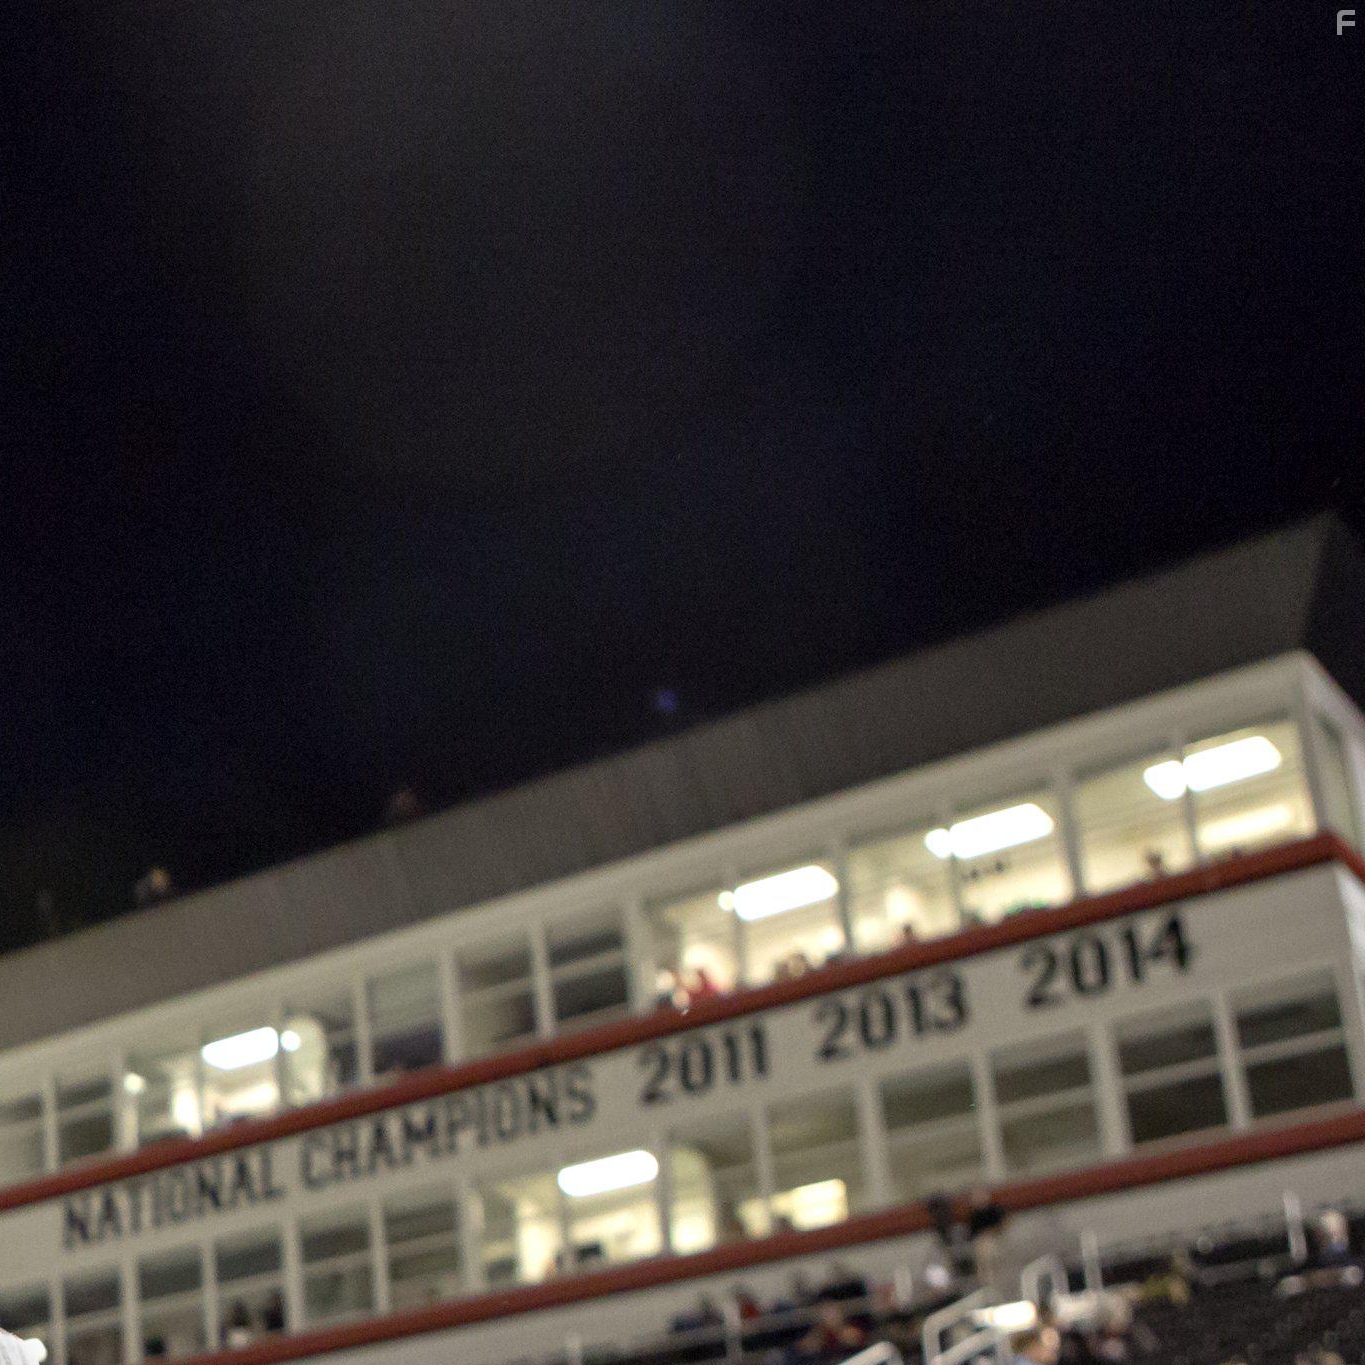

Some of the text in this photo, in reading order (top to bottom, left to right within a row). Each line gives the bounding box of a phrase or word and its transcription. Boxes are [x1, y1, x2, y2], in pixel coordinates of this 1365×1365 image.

[64, 912, 1193, 1249] NATIONAL CHAMPIONS 2011 2013 2014
